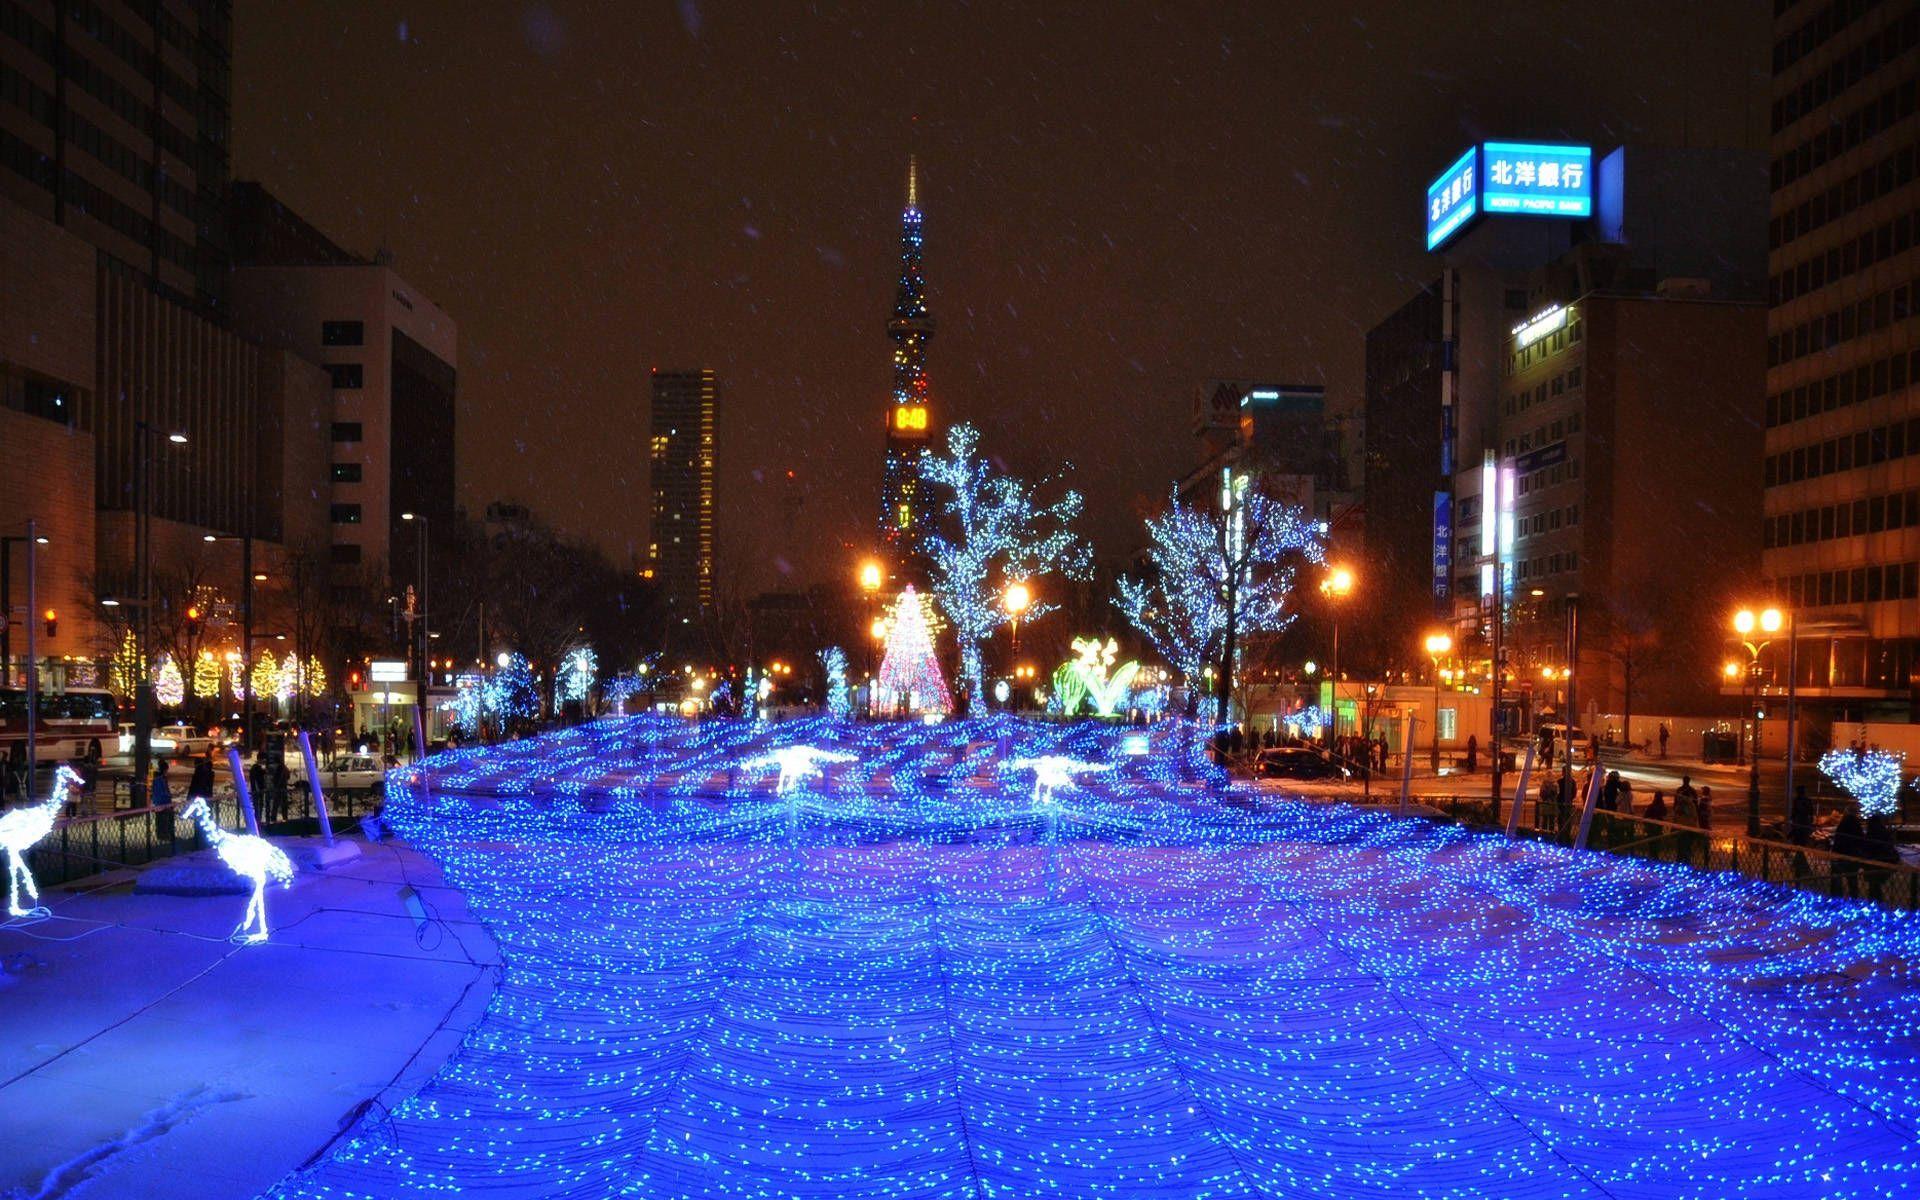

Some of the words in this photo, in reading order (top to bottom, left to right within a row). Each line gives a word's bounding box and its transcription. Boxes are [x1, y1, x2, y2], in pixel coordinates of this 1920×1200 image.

[1431, 166, 1473, 221] 北洋銀行
[1491, 159, 1583, 188] 北洋銀行
[1436, 525, 1449, 598] 北洋銀行
